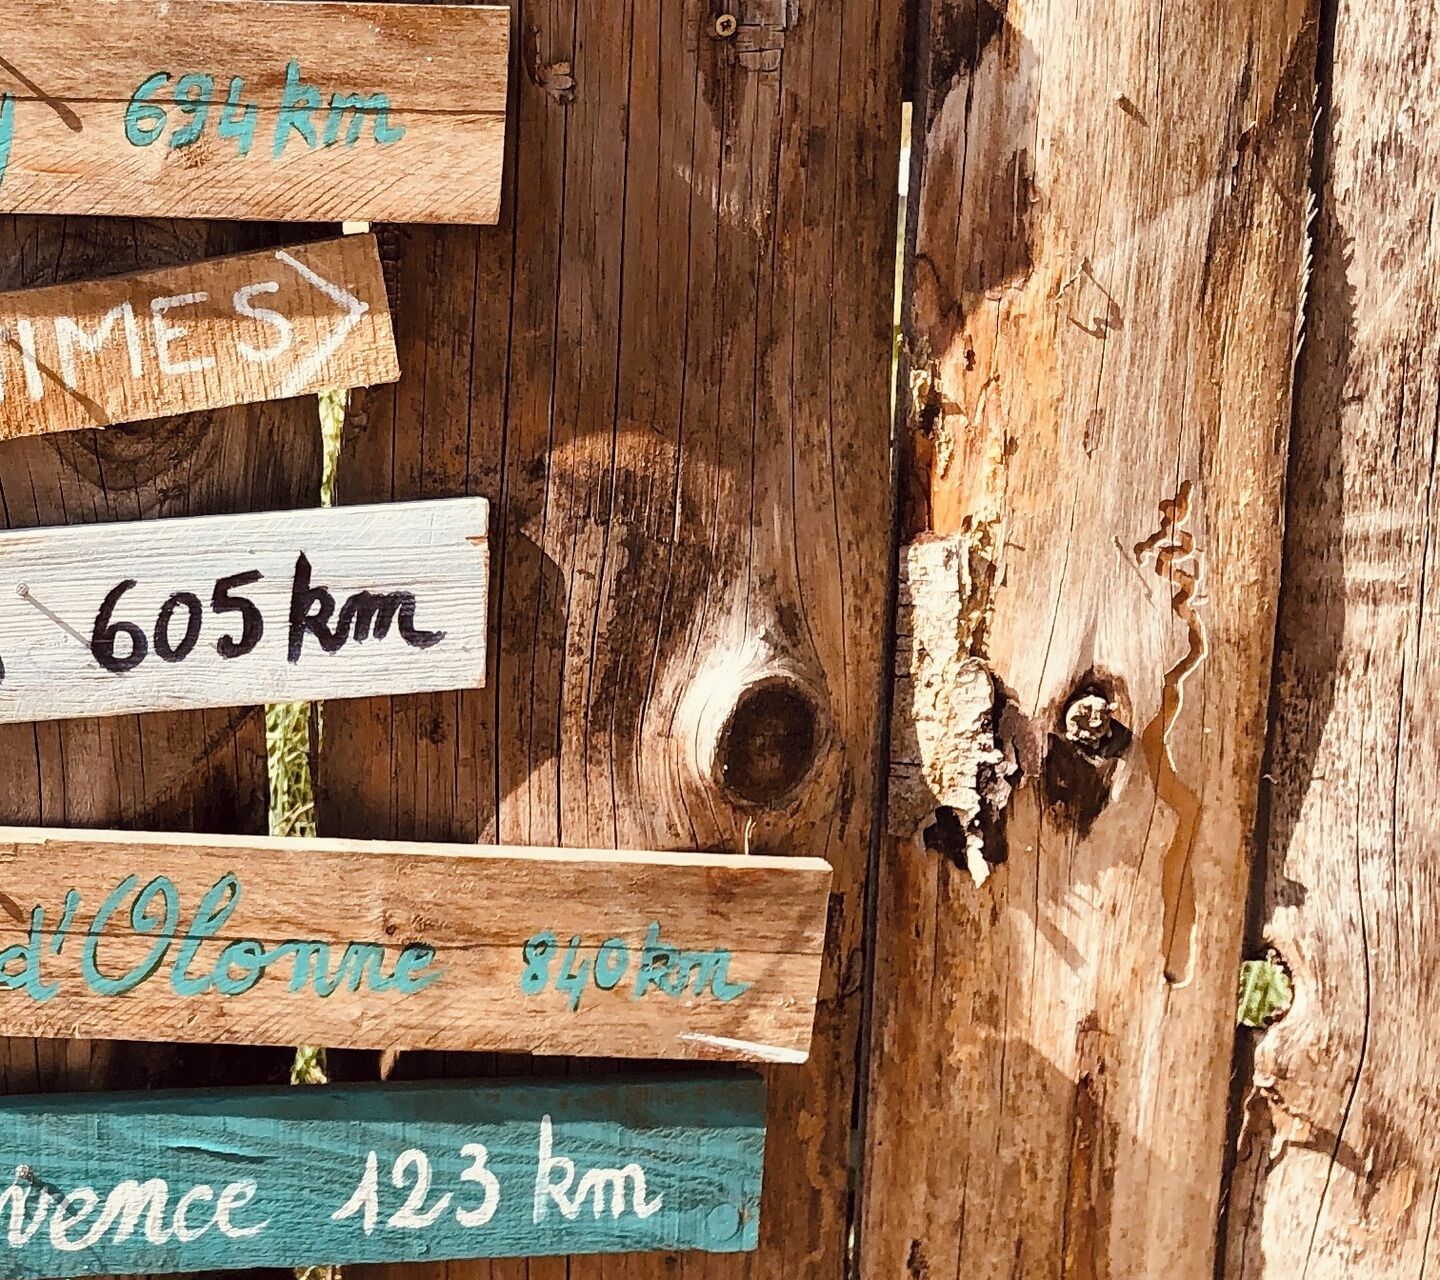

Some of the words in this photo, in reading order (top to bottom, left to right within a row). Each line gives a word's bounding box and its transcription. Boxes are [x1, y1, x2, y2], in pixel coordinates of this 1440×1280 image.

[126, 72, 255, 158] 694
[272, 60, 405, 158] km
[90, 569, 264, 673] 605
[287, 551, 447, 663] km
[520, 930, 629, 1013] 840
[631, 920, 756, 1002] km
[331, 1144, 499, 1231] 123
[535, 1114, 664, 1225] km
